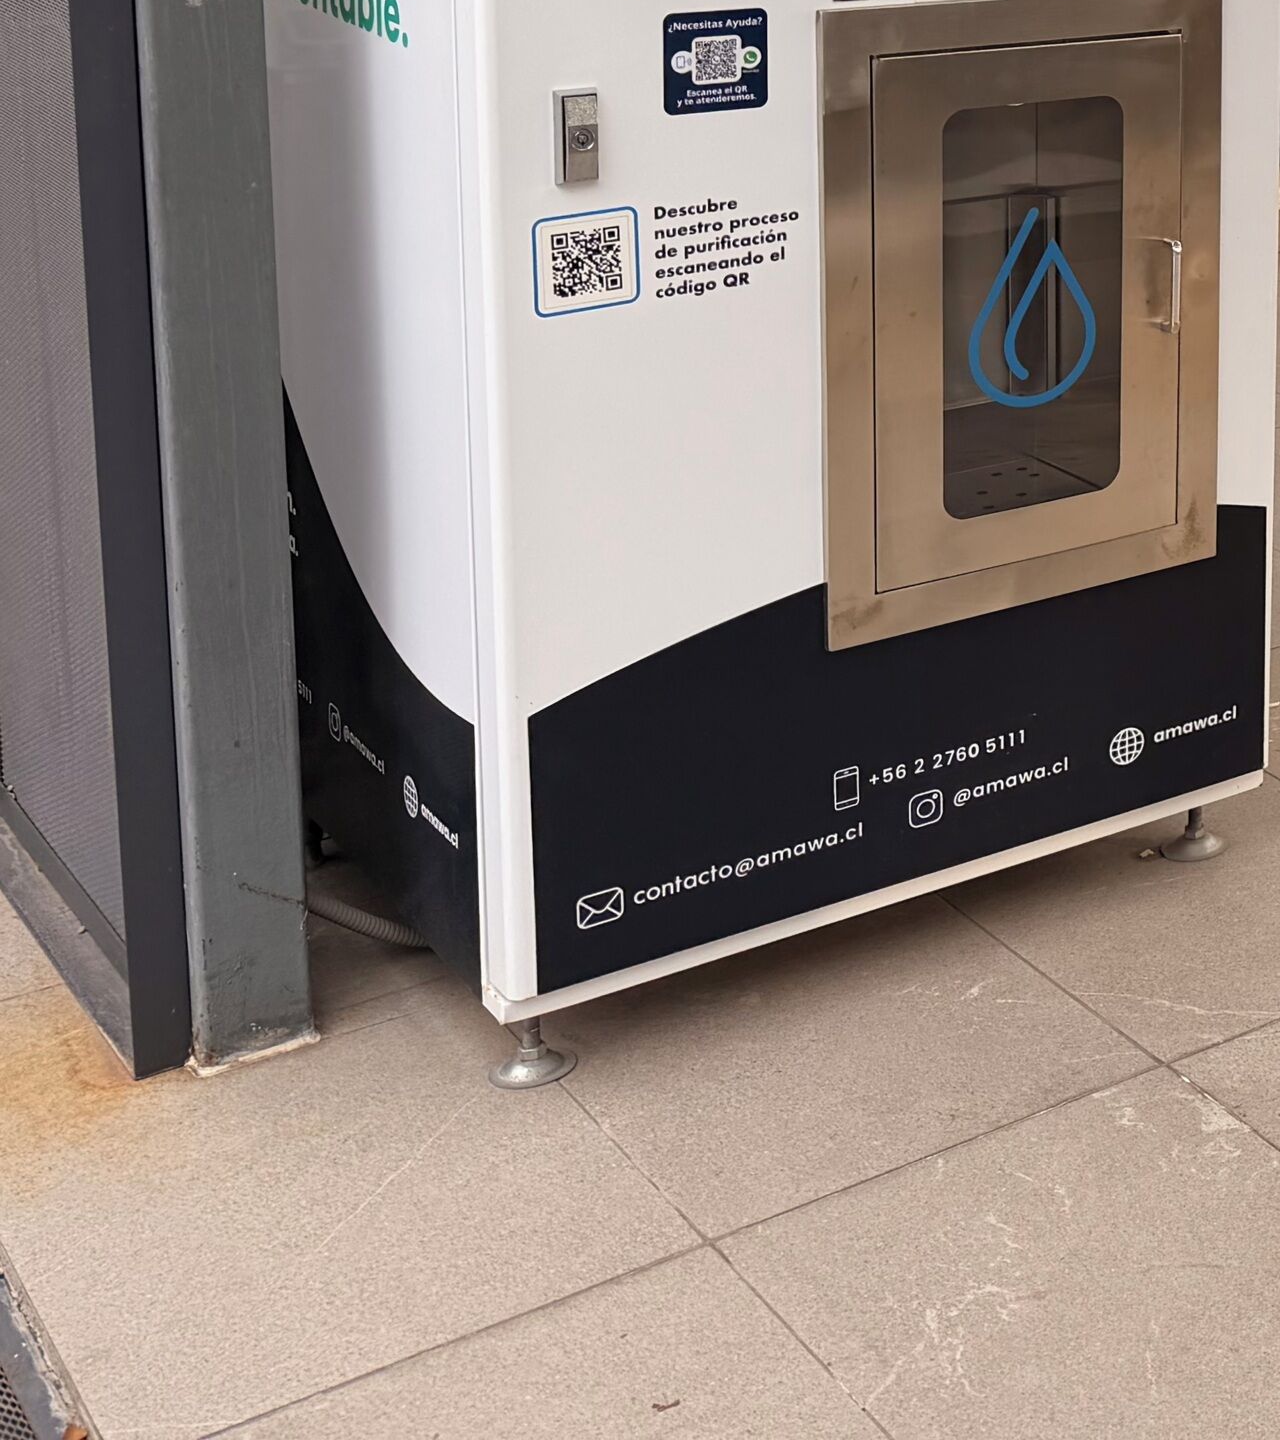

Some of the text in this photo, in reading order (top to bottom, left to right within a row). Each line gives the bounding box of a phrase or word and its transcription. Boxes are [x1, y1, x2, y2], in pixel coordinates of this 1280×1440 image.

[668, 16, 763, 33] ¿Necesitas Ayuda?
[676, 99, 683, 108] y
[695, 93, 757, 105] atenderemos.
[686, 85, 748, 97] Escanea el QR
[653, 198, 738, 220] Descubre
[654, 211, 799, 240] nuestro proceso
[654, 229, 788, 259] de purificación
[655, 246, 785, 279] escaneando el
[655, 272, 750, 298] código QR
[1153, 704, 1238, 746] amawa.cl
[868, 728, 1027, 786] +56 2 2760 5111
[953, 756, 1070, 808] @amawa.cl
[421, 803, 459, 850] amawa.cl
[633, 822, 864, 906] contacto@amawa.cl
